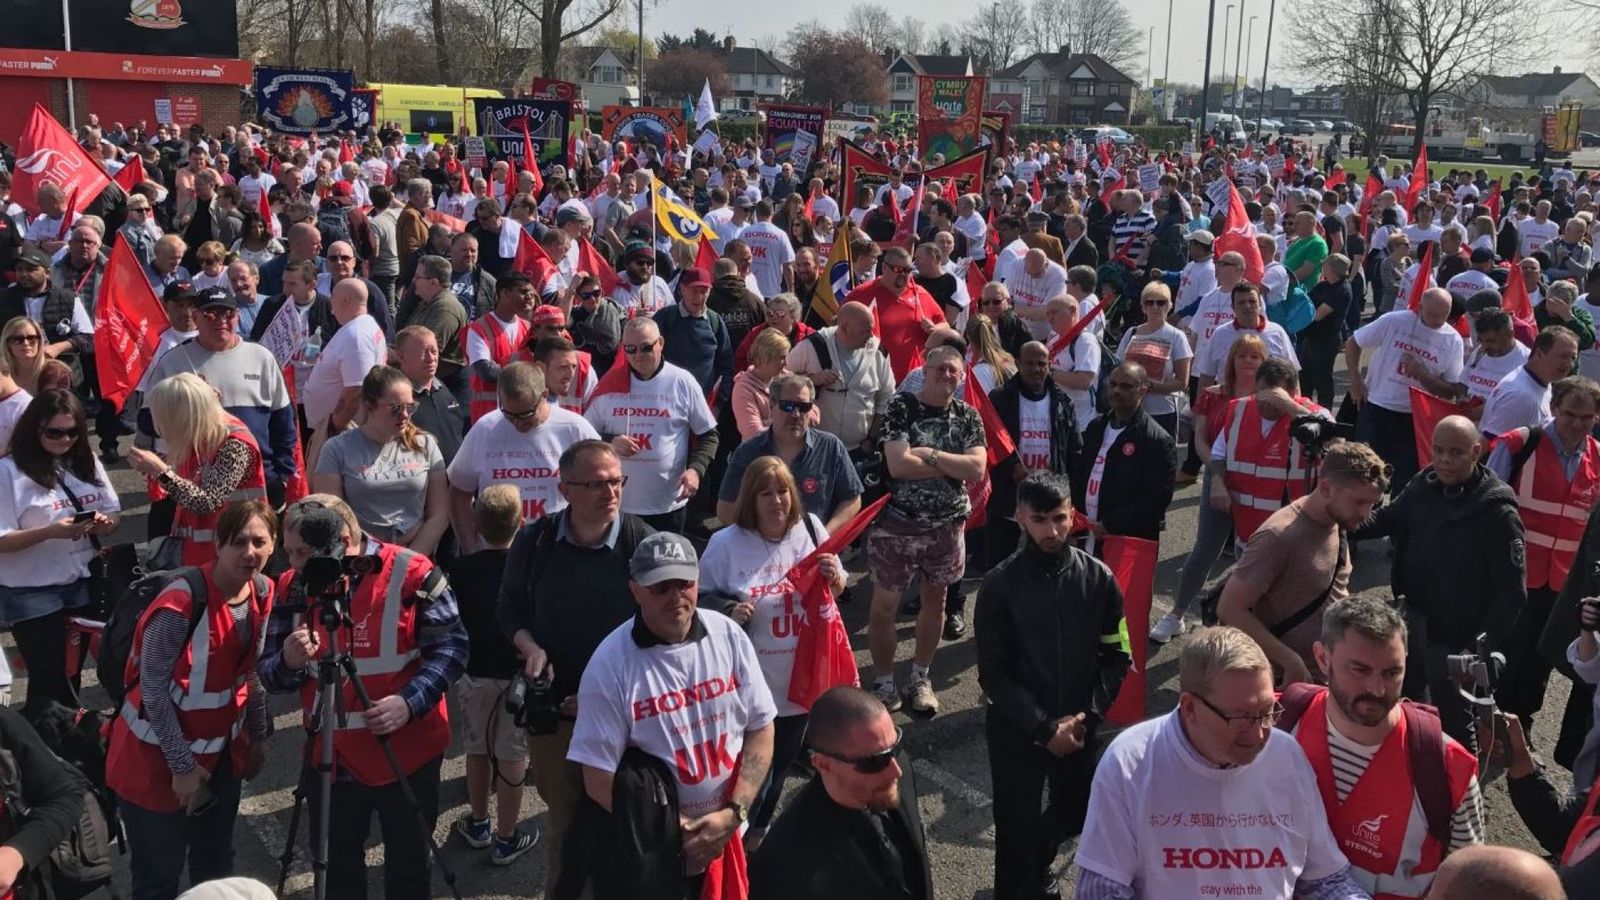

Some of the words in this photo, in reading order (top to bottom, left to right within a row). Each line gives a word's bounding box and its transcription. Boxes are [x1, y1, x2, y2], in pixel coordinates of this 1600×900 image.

[935, 80, 968, 89] CYMRU
[495, 104, 545, 123] BRISTOL
[768, 117, 821, 131] EQUALITY
[744, 231, 778, 241] HONDA
[751, 246, 767, 258] UK
[1393, 340, 1439, 364] HONDA
[611, 407, 671, 418] HONDA
[1023, 453, 1049, 469] UK
[492, 467, 561, 480] HONDA
[750, 582, 796, 599] HON
[632, 671, 741, 723] HONDA
[671, 723, 689, 738] stay
[712, 711, 726, 724] the
[674, 731, 735, 786] UK
[1162, 846, 1289, 870] HONDA
[1200, 884, 1221, 897] stay
[1223, 884, 1246, 896] with
[1247, 884, 1264, 896] the
